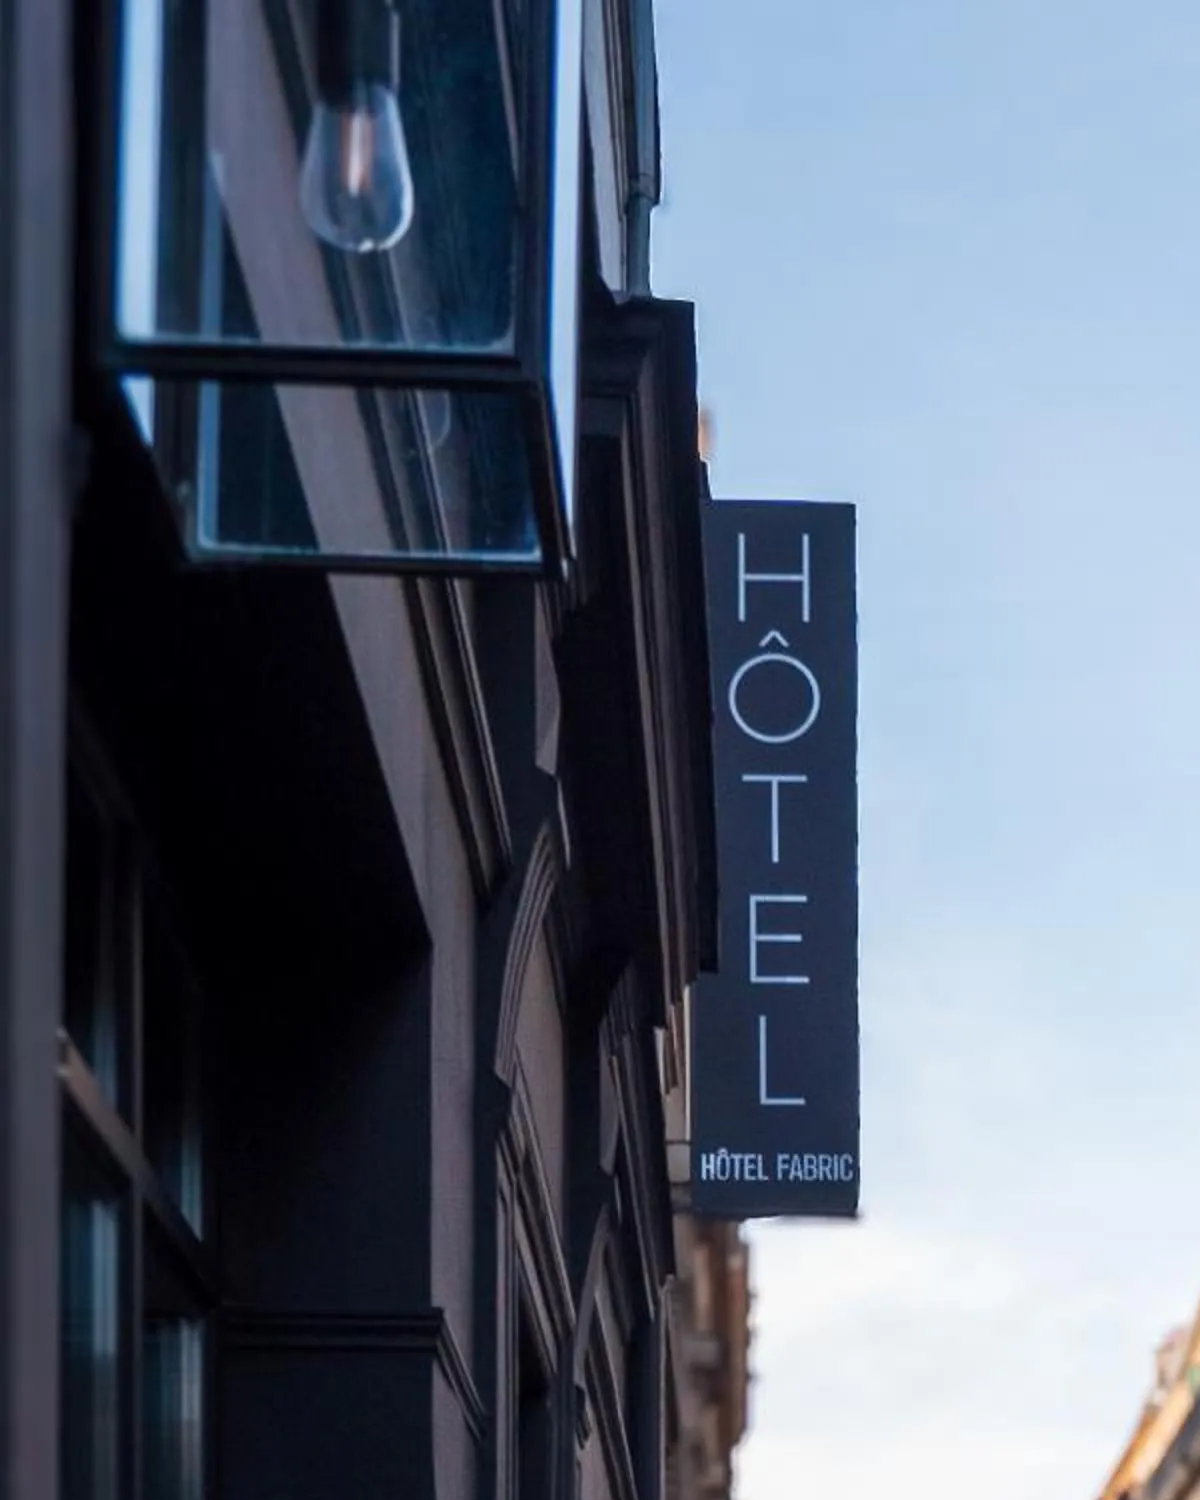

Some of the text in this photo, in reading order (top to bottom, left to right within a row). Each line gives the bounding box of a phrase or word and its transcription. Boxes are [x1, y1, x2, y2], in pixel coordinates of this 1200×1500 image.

[729, 533, 820, 1105] HÔTEL
[701, 1148, 854, 1181] HÔTEL FABRIC
